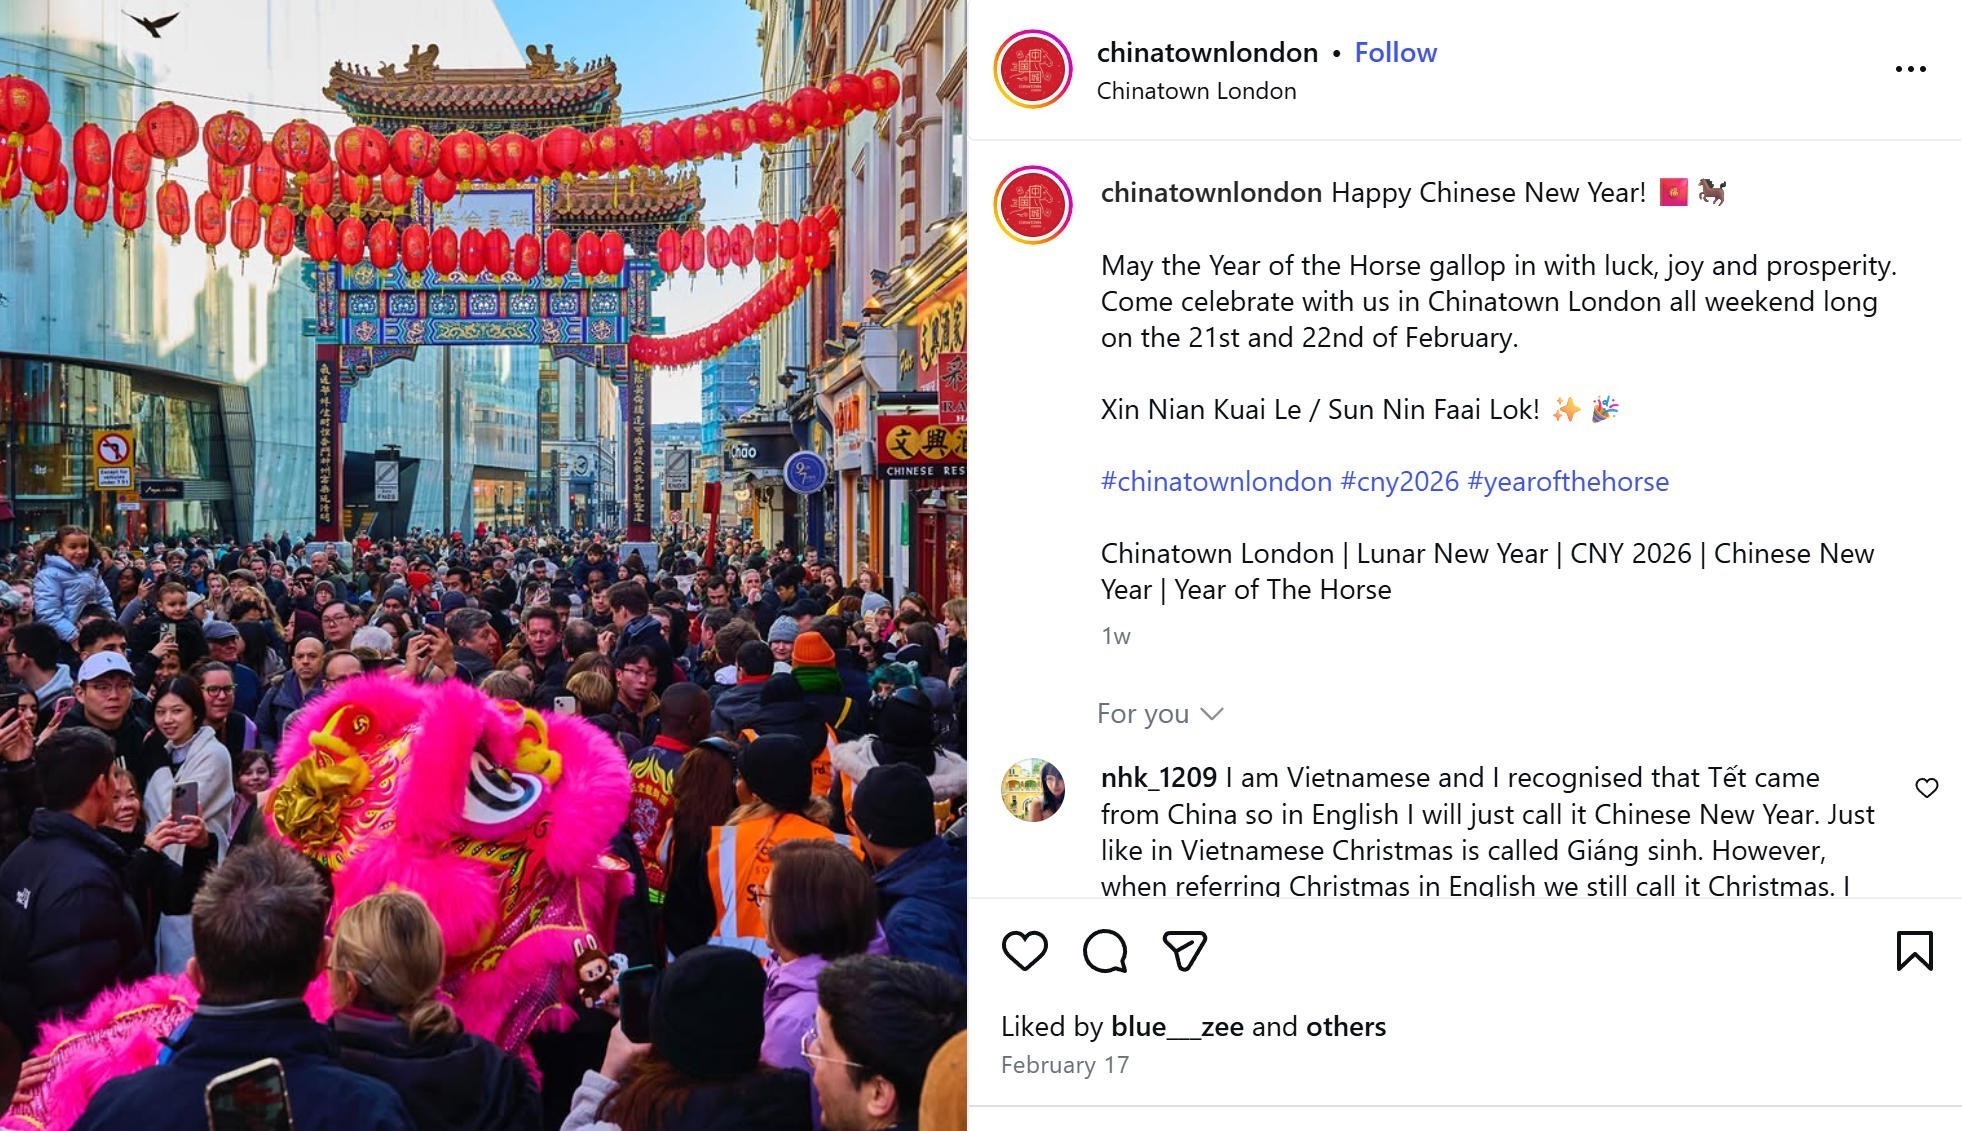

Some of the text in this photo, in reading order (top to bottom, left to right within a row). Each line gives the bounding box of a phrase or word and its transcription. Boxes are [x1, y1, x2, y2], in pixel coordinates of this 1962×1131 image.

[942, 401, 967, 413] RA
[886, 466, 966, 476] CHINESE RES
